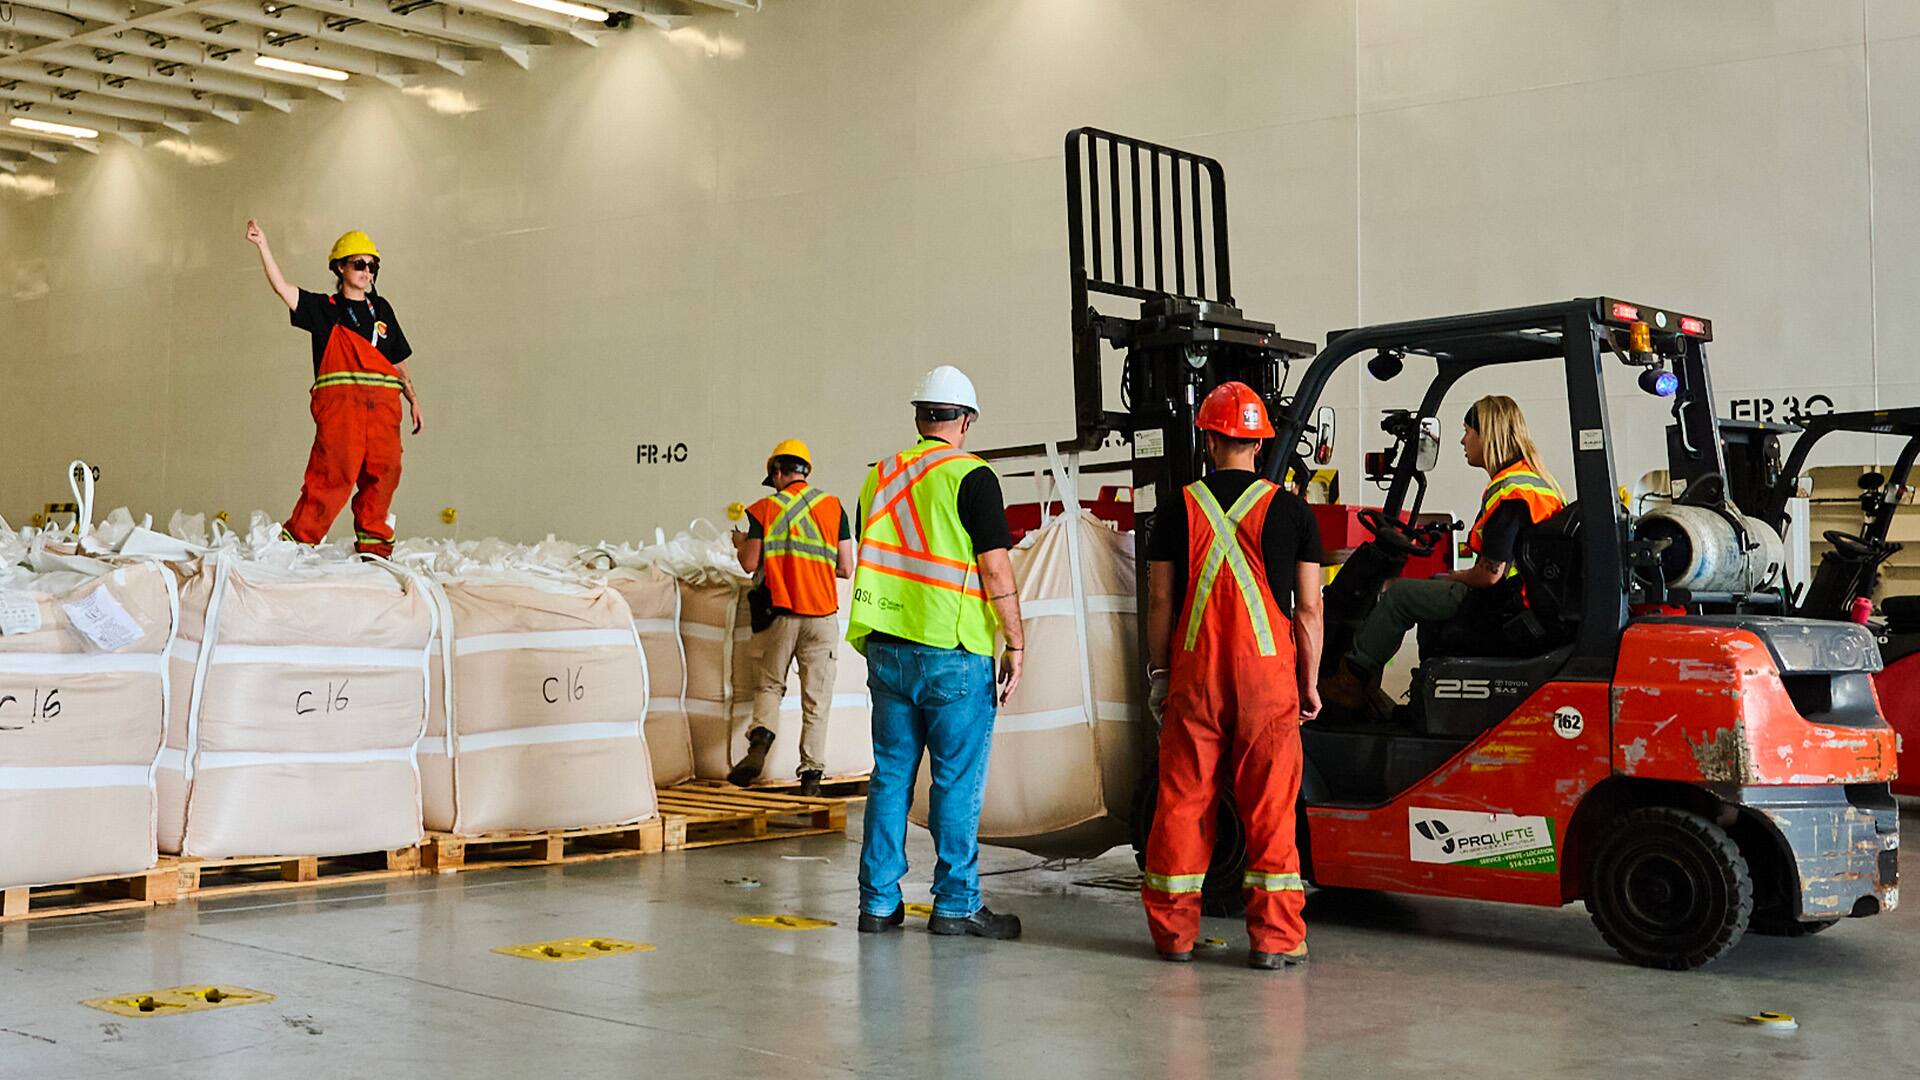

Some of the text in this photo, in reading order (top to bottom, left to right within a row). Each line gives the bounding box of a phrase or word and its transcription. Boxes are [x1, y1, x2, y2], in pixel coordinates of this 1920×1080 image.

[854, 587, 872, 605] QSL
[1434, 679, 1490, 699] 25
[1504, 679, 1529, 688] TOYOTA
[1480, 856, 1501, 865] SERVICE
[1526, 847, 1555, 857] LOCATION
